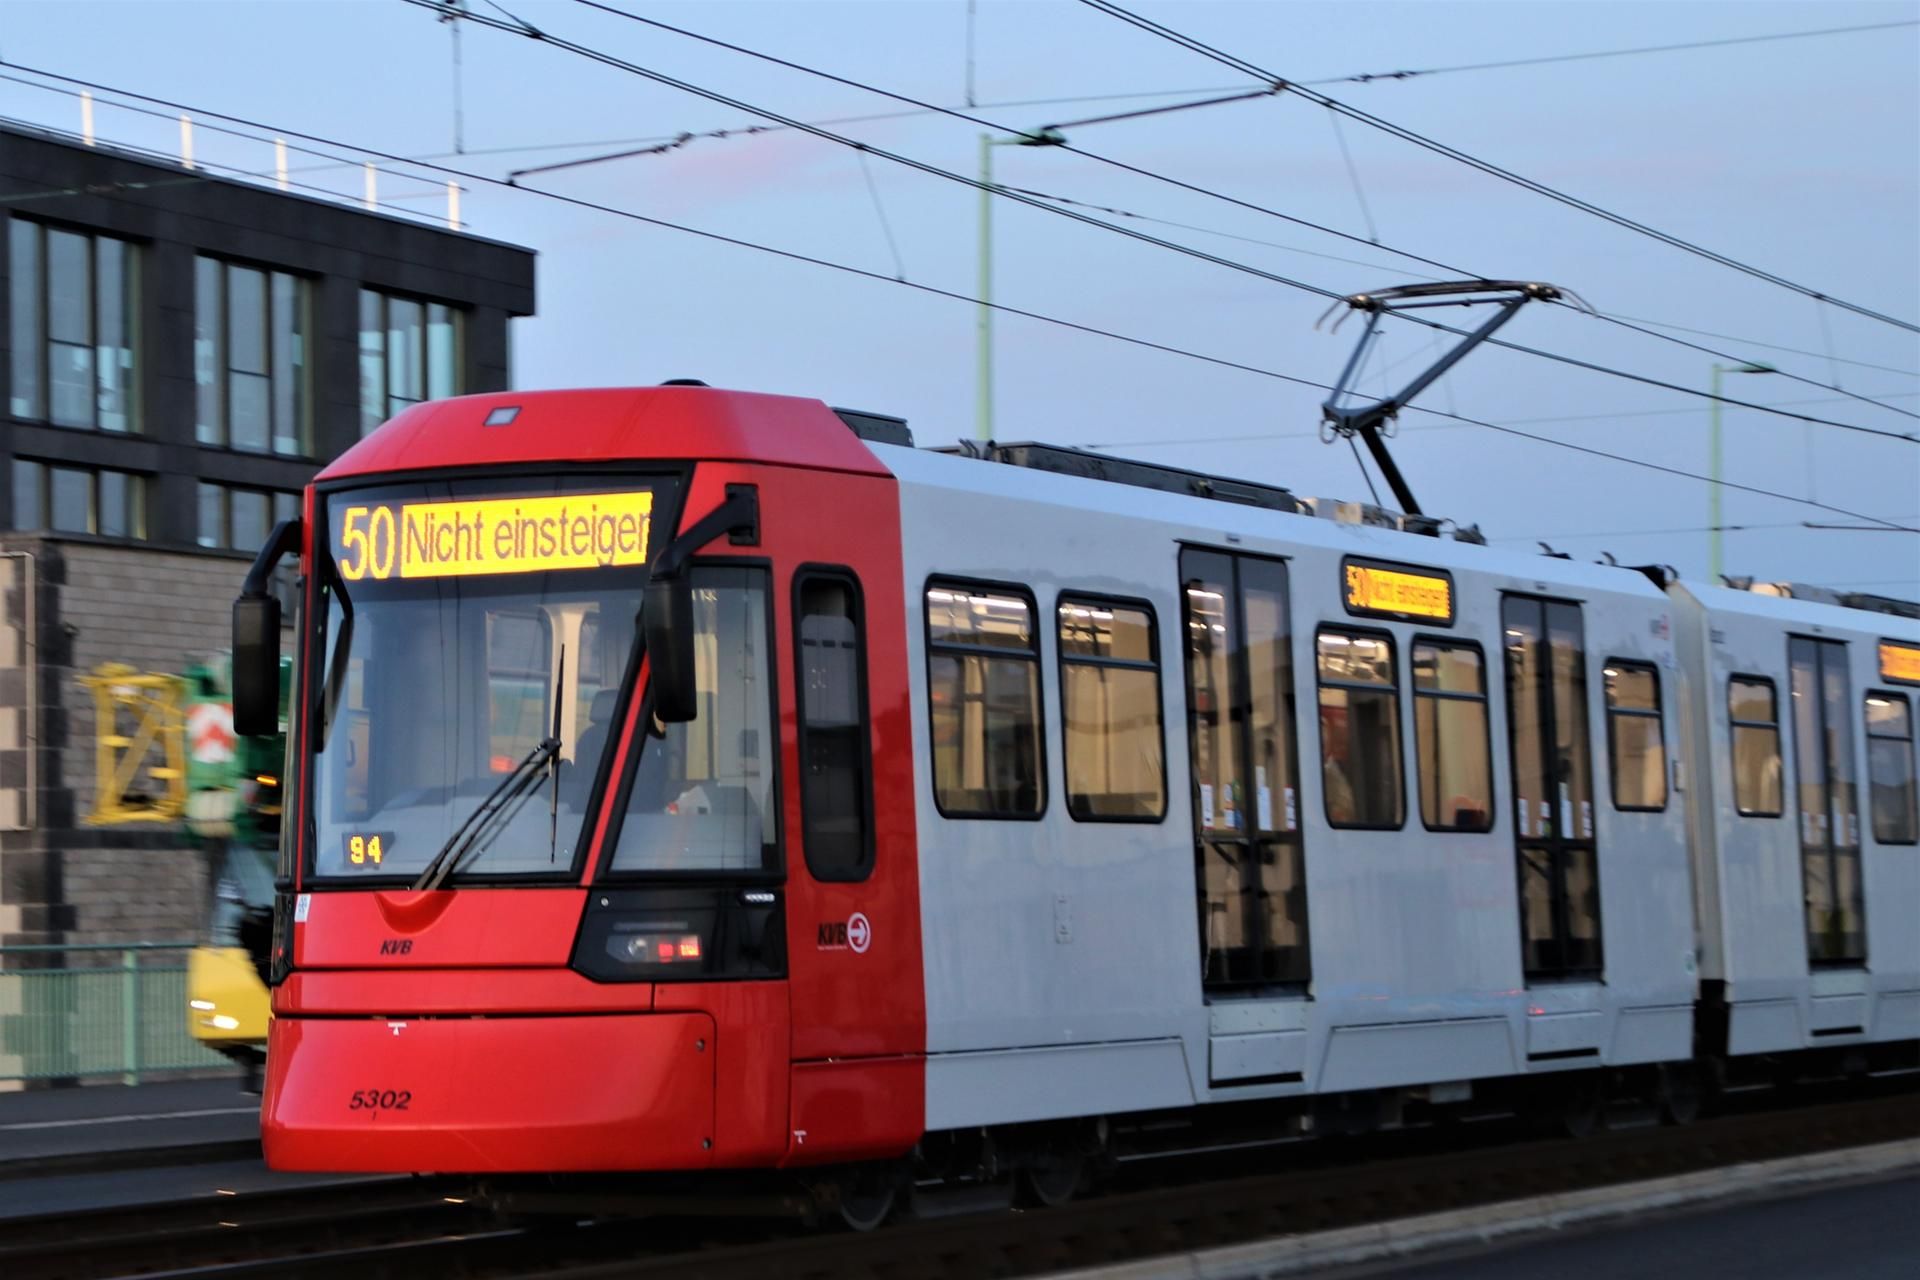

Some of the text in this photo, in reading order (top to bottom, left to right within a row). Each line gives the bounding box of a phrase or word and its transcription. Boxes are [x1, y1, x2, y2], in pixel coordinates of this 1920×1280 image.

[341, 505, 395, 580] 50
[405, 510, 484, 564] Nicht
[350, 835, 382, 864] 94
[818, 923, 847, 945] KVB
[380, 940, 413, 955] KVB
[349, 1089, 411, 1110] 5302
